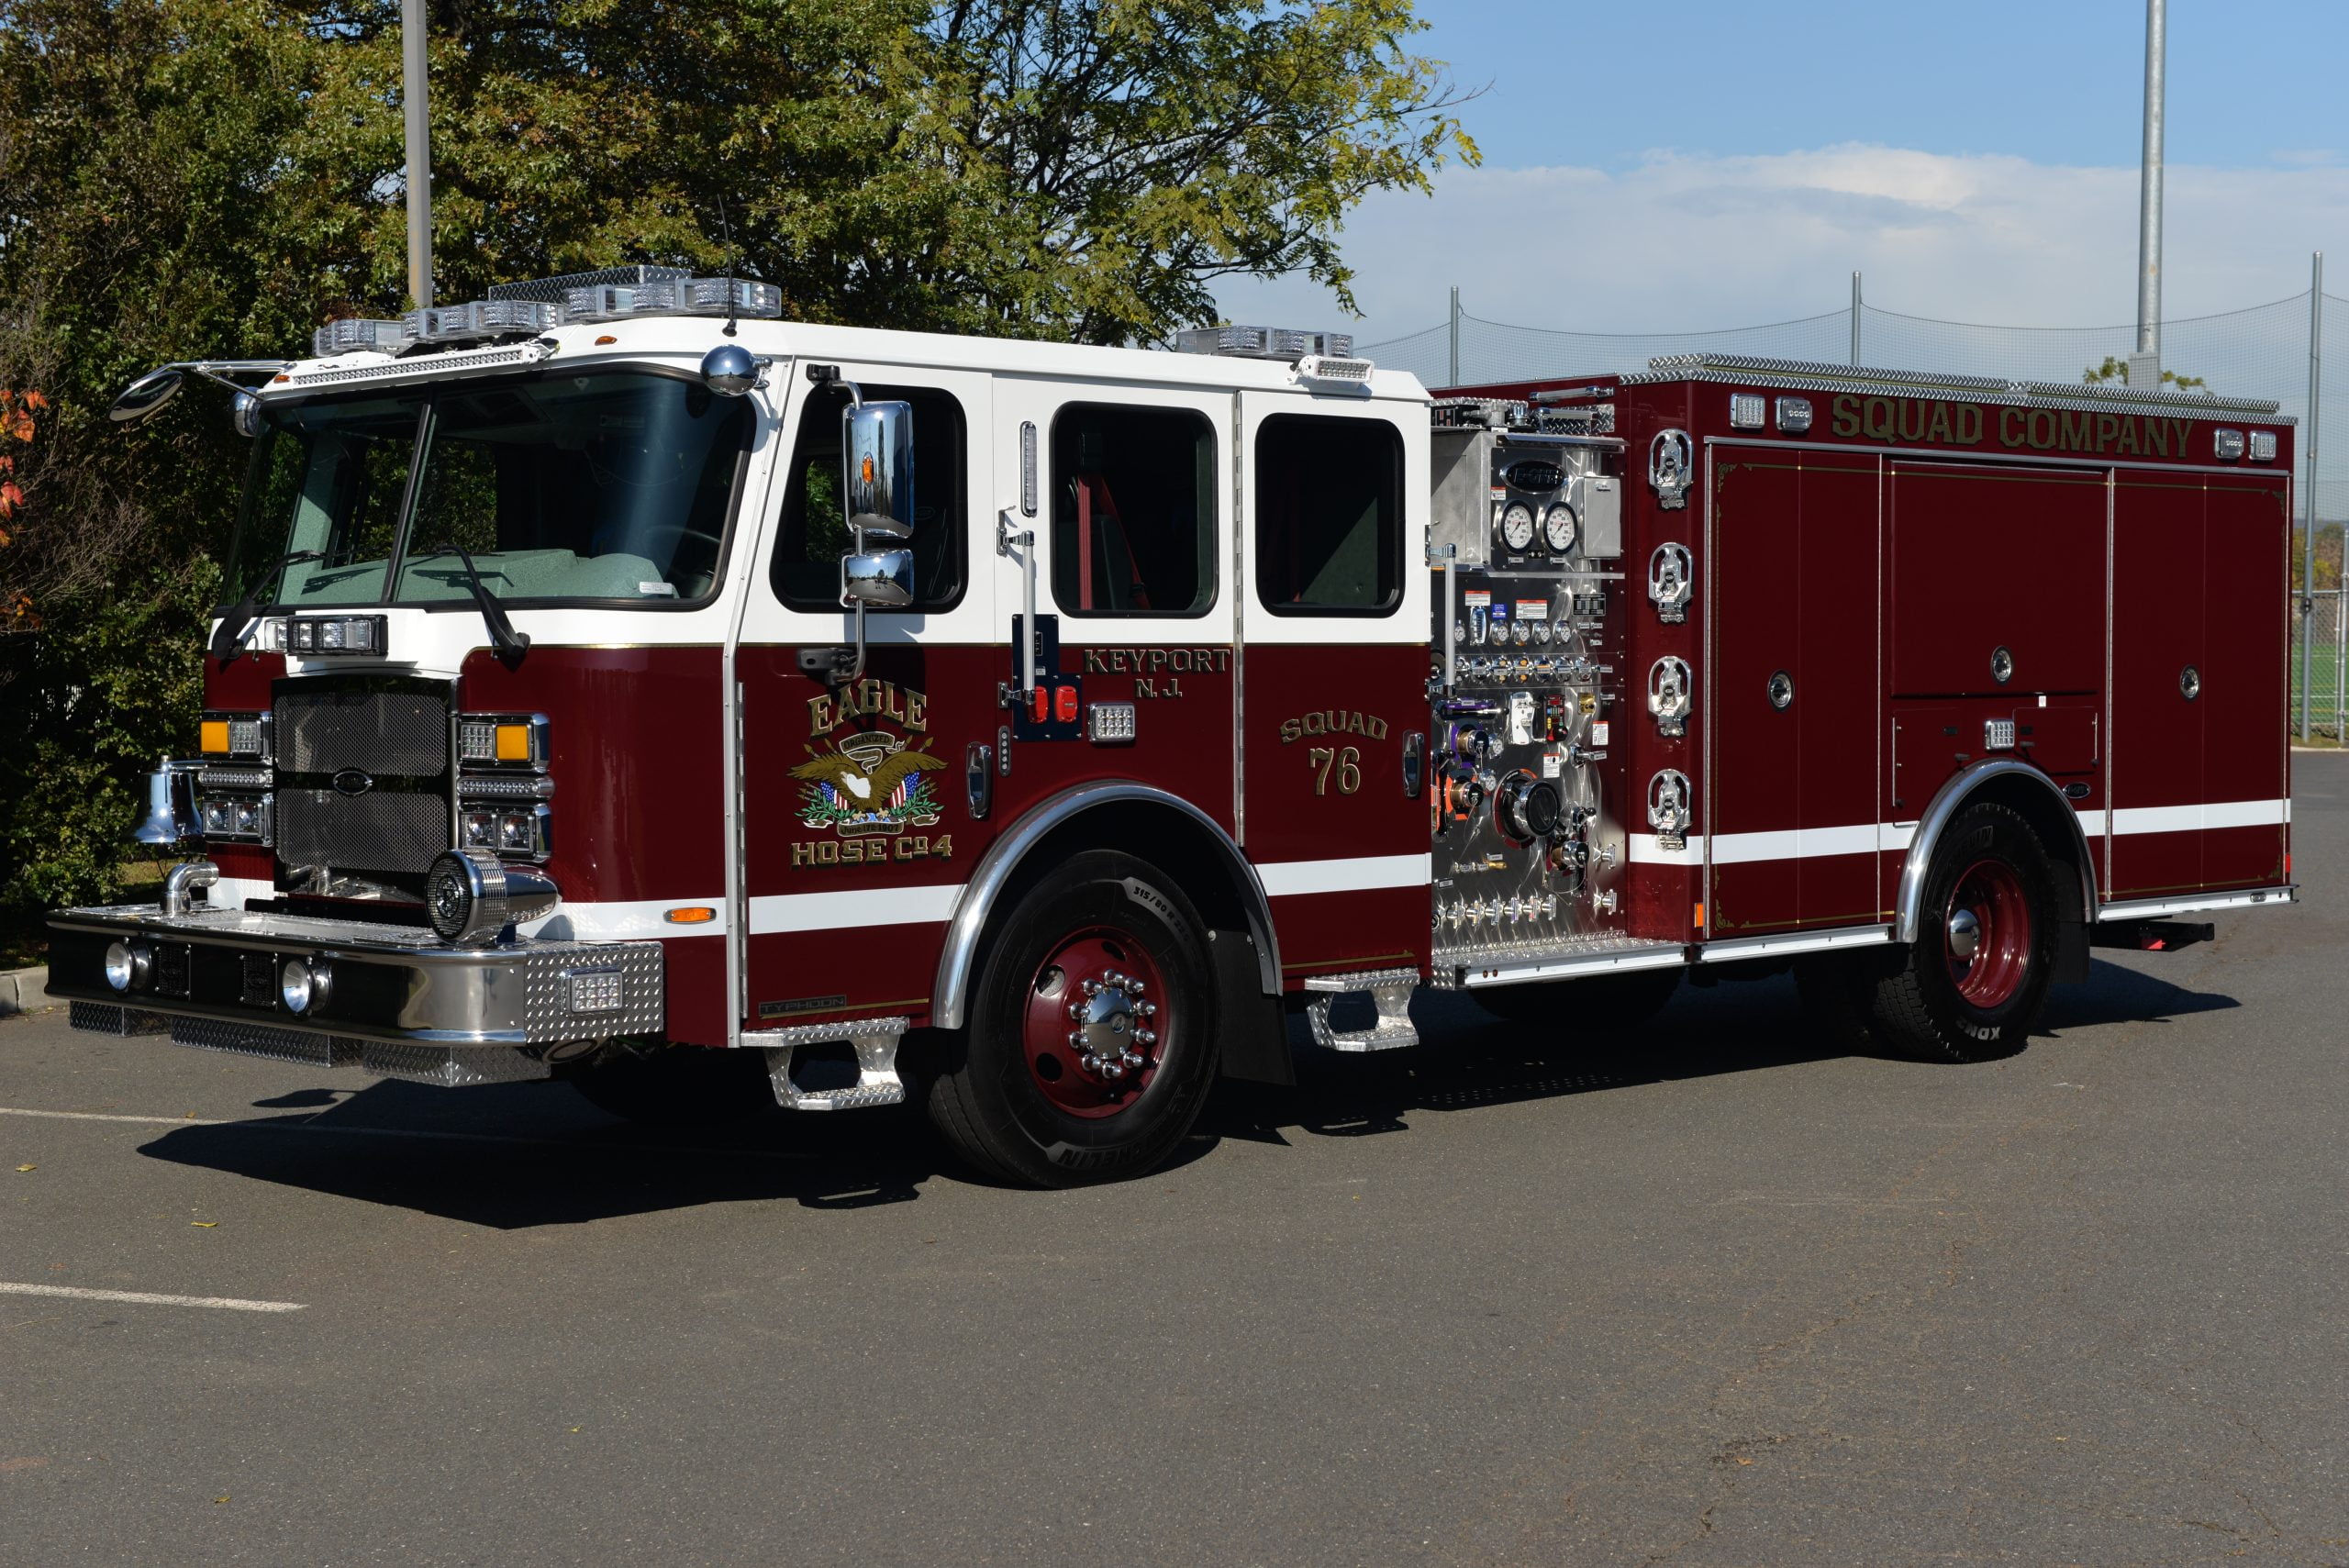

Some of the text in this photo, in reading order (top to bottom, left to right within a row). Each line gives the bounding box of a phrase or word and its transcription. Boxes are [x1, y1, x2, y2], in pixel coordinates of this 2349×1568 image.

[1832, 395, 2195, 457] SQUAD COMPANY
[1085, 649, 1230, 673] KEYPORT
[807, 678, 927, 736] EAGLE
[1280, 710, 1387, 742] SQUAD
[843, 734, 890, 749] ORGANIZED
[1309, 747, 1360, 795] 76
[791, 839, 886, 865] HOSE
[1133, 886, 1166, 911] 315/80
[761, 997, 844, 1013] TYPHOON
